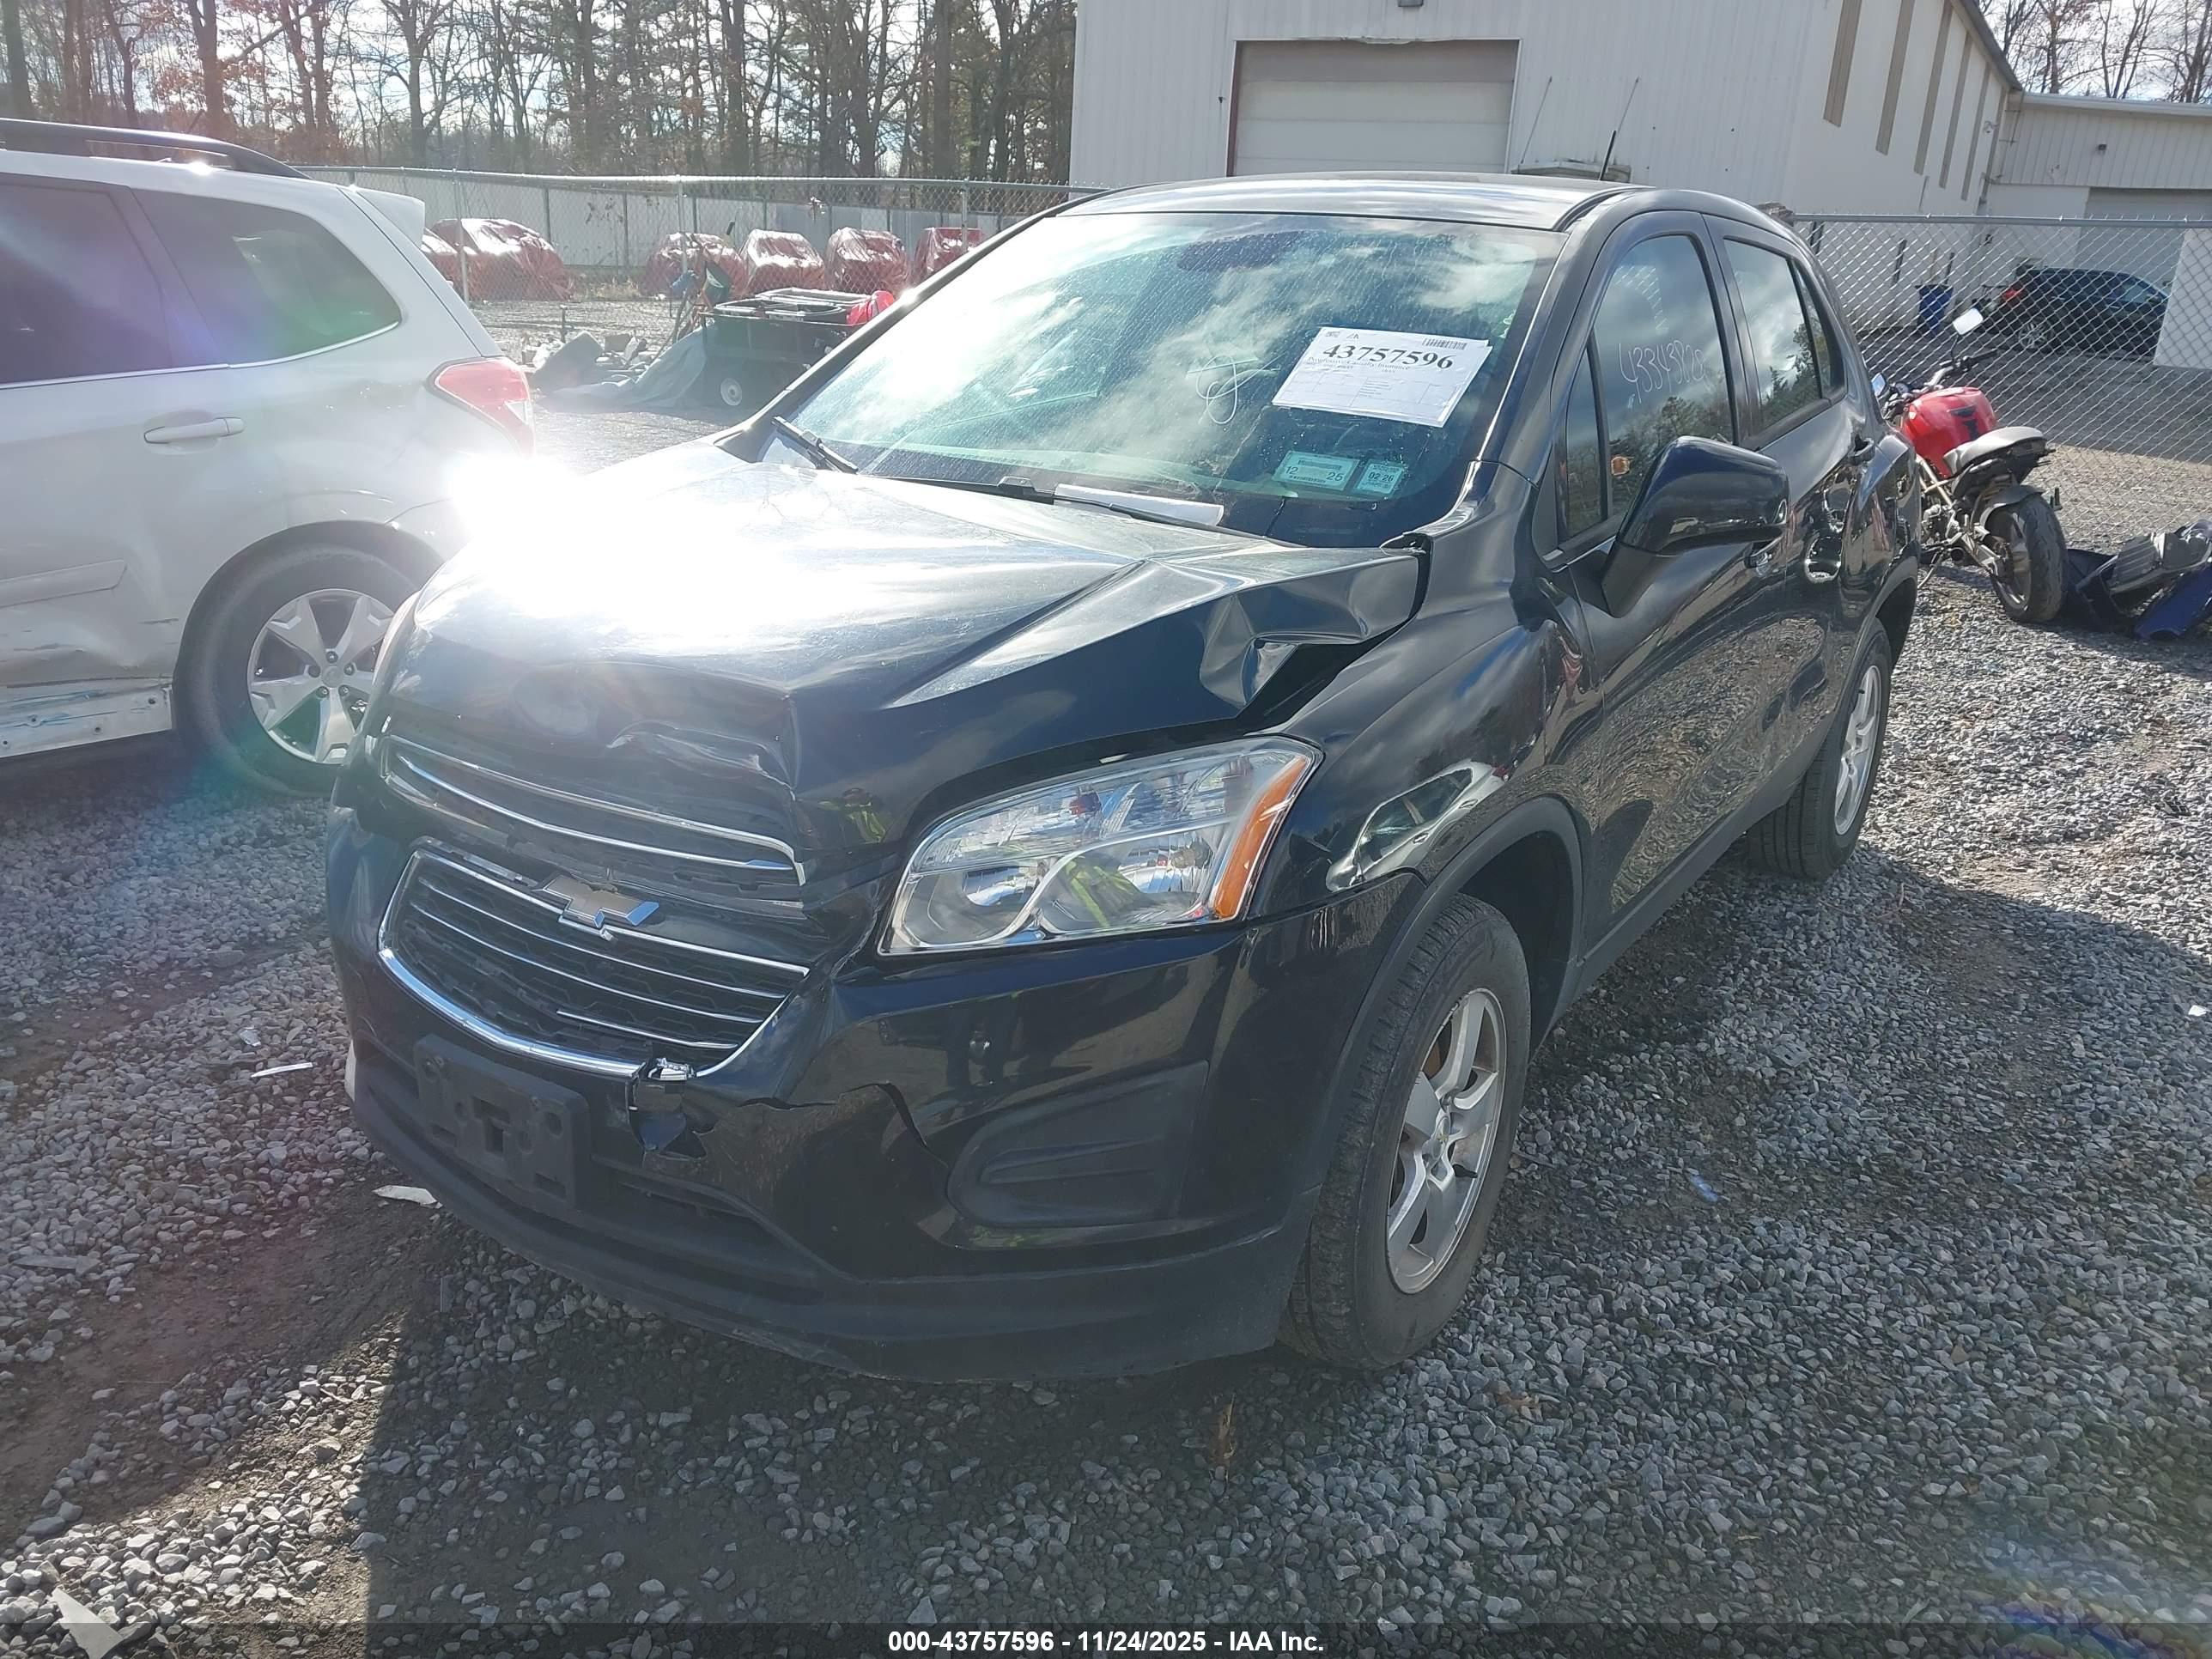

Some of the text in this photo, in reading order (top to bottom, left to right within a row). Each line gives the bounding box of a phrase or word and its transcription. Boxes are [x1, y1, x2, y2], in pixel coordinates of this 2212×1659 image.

[1323, 344, 1456, 370] 43757596
[1285, 465, 1298, 475] 12
[1325, 471, 1344, 482] 25
